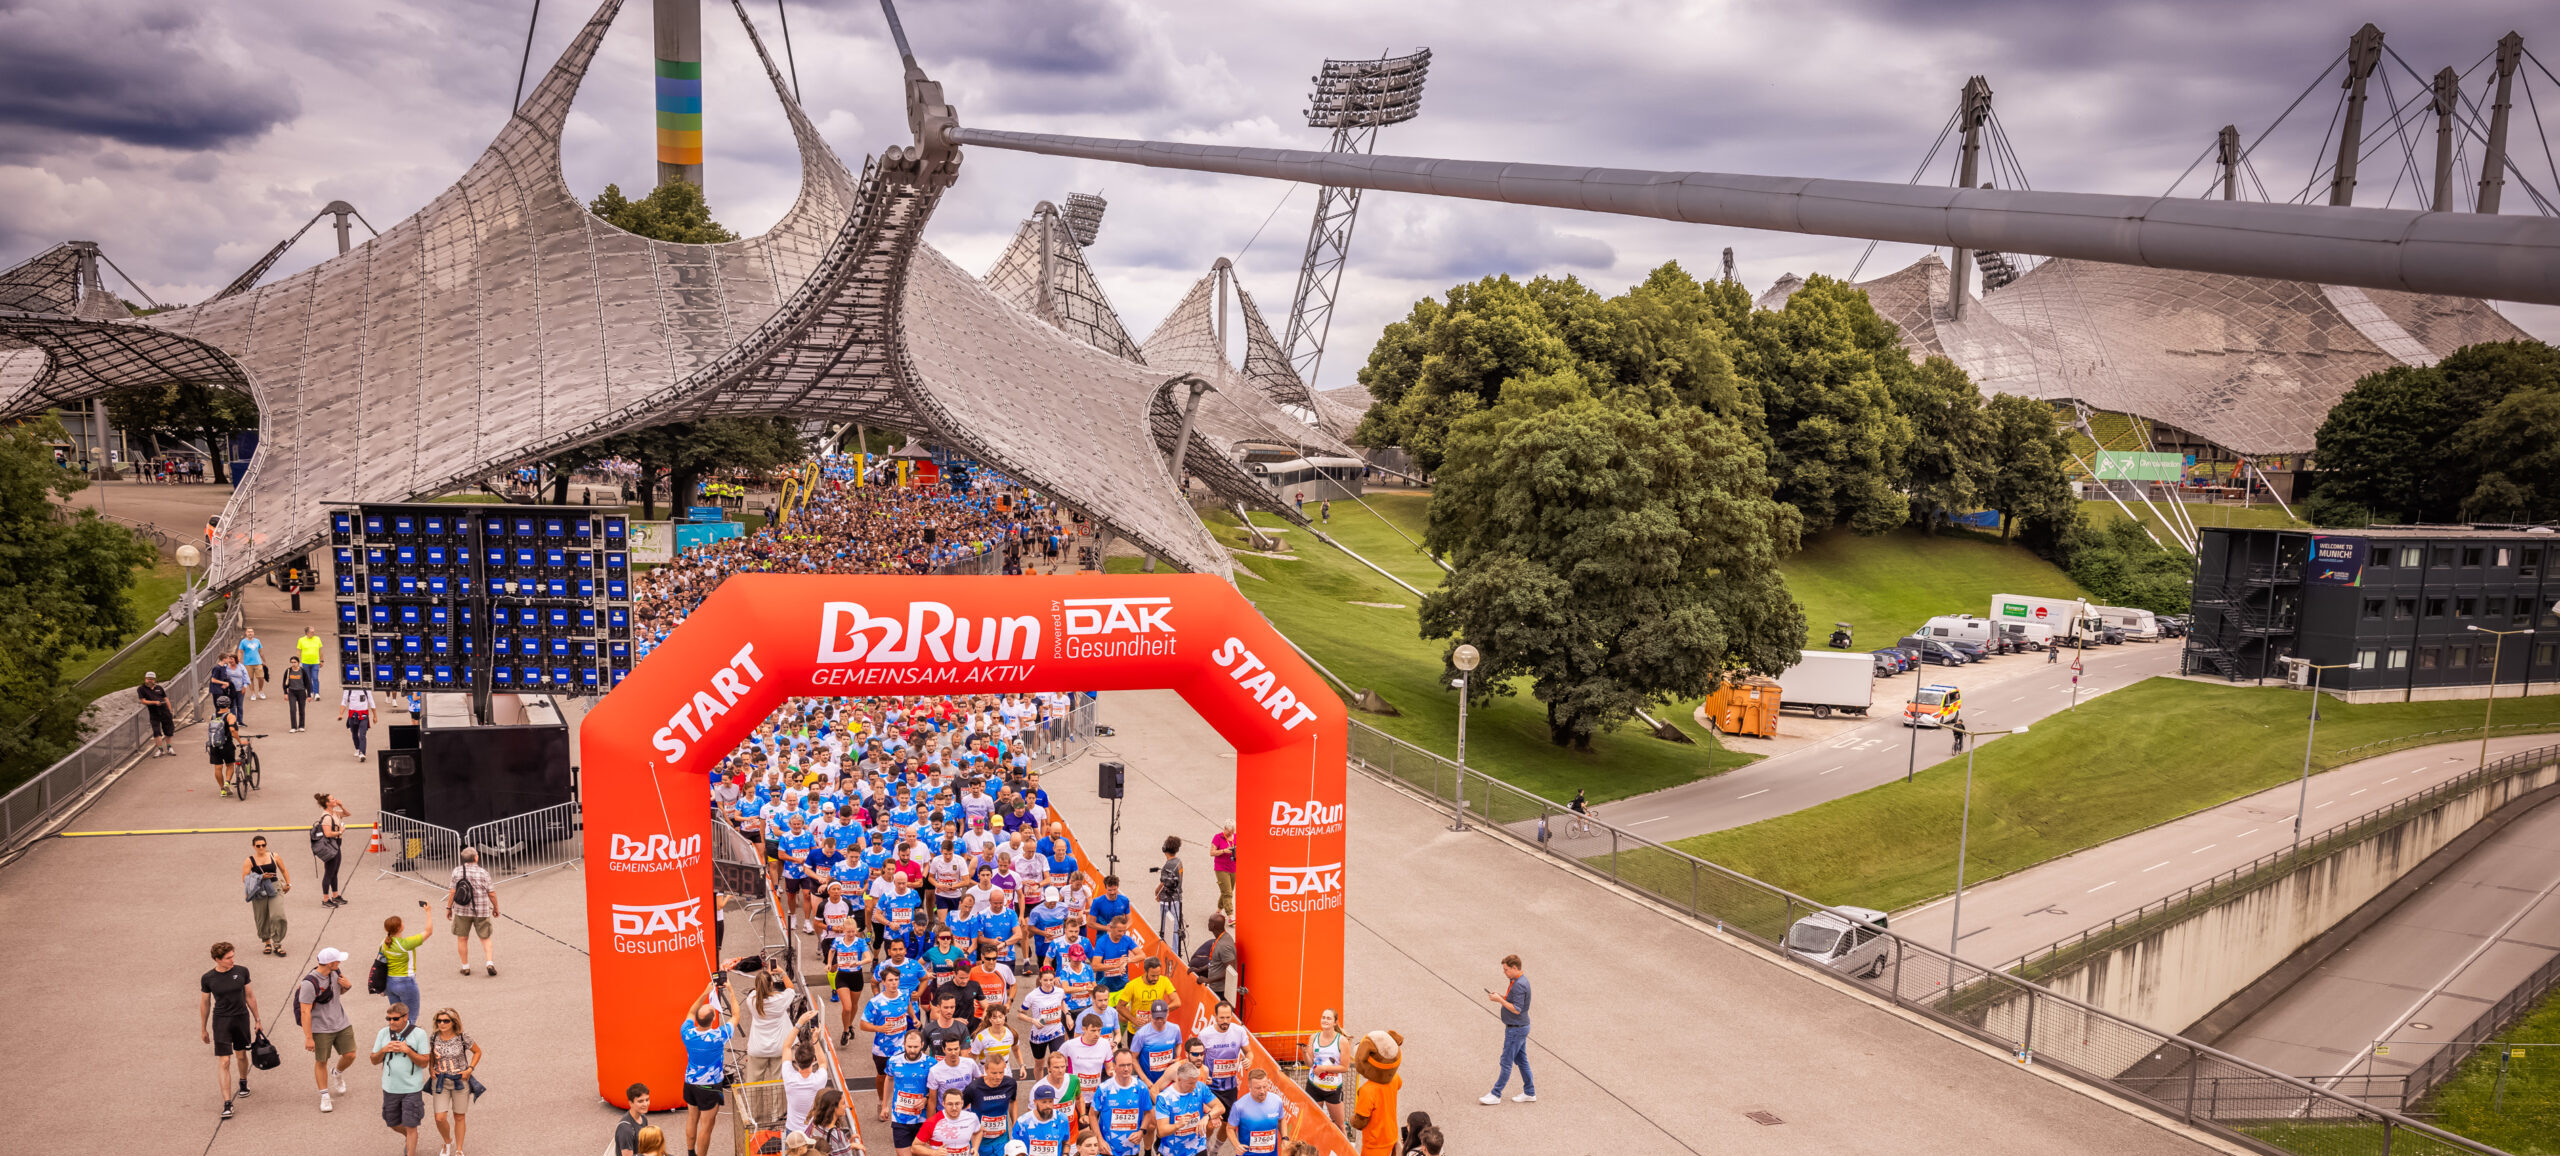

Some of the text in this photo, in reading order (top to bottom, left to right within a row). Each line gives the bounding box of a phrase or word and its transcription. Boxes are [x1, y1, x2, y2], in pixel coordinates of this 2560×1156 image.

[2319, 550, 2352, 559] MUNICH!
[1063, 597, 1177, 635] DAK
[816, 601, 1041, 664] B2Run
[1051, 600, 1062, 659] powered by
[1066, 633, 1177, 659] Gesundheit
[811, 664, 1036, 686] GEMEINSAM. AKTIV
[1211, 637, 1318, 732] START
[652, 642, 764, 764] START
[1270, 800, 1344, 826] B2Run
[1326, 823, 1343, 834] AKTIV
[610, 833, 701, 862] B2Run
[675, 855, 701, 870] AKTIV
[1269, 862, 1342, 895] DAK
[1269, 890, 1342, 912] Gesundheit
[611, 896, 703, 936] DAK
[614, 928, 704, 954] Gesundheit
[1032, 1145, 1056, 1153] 35393
